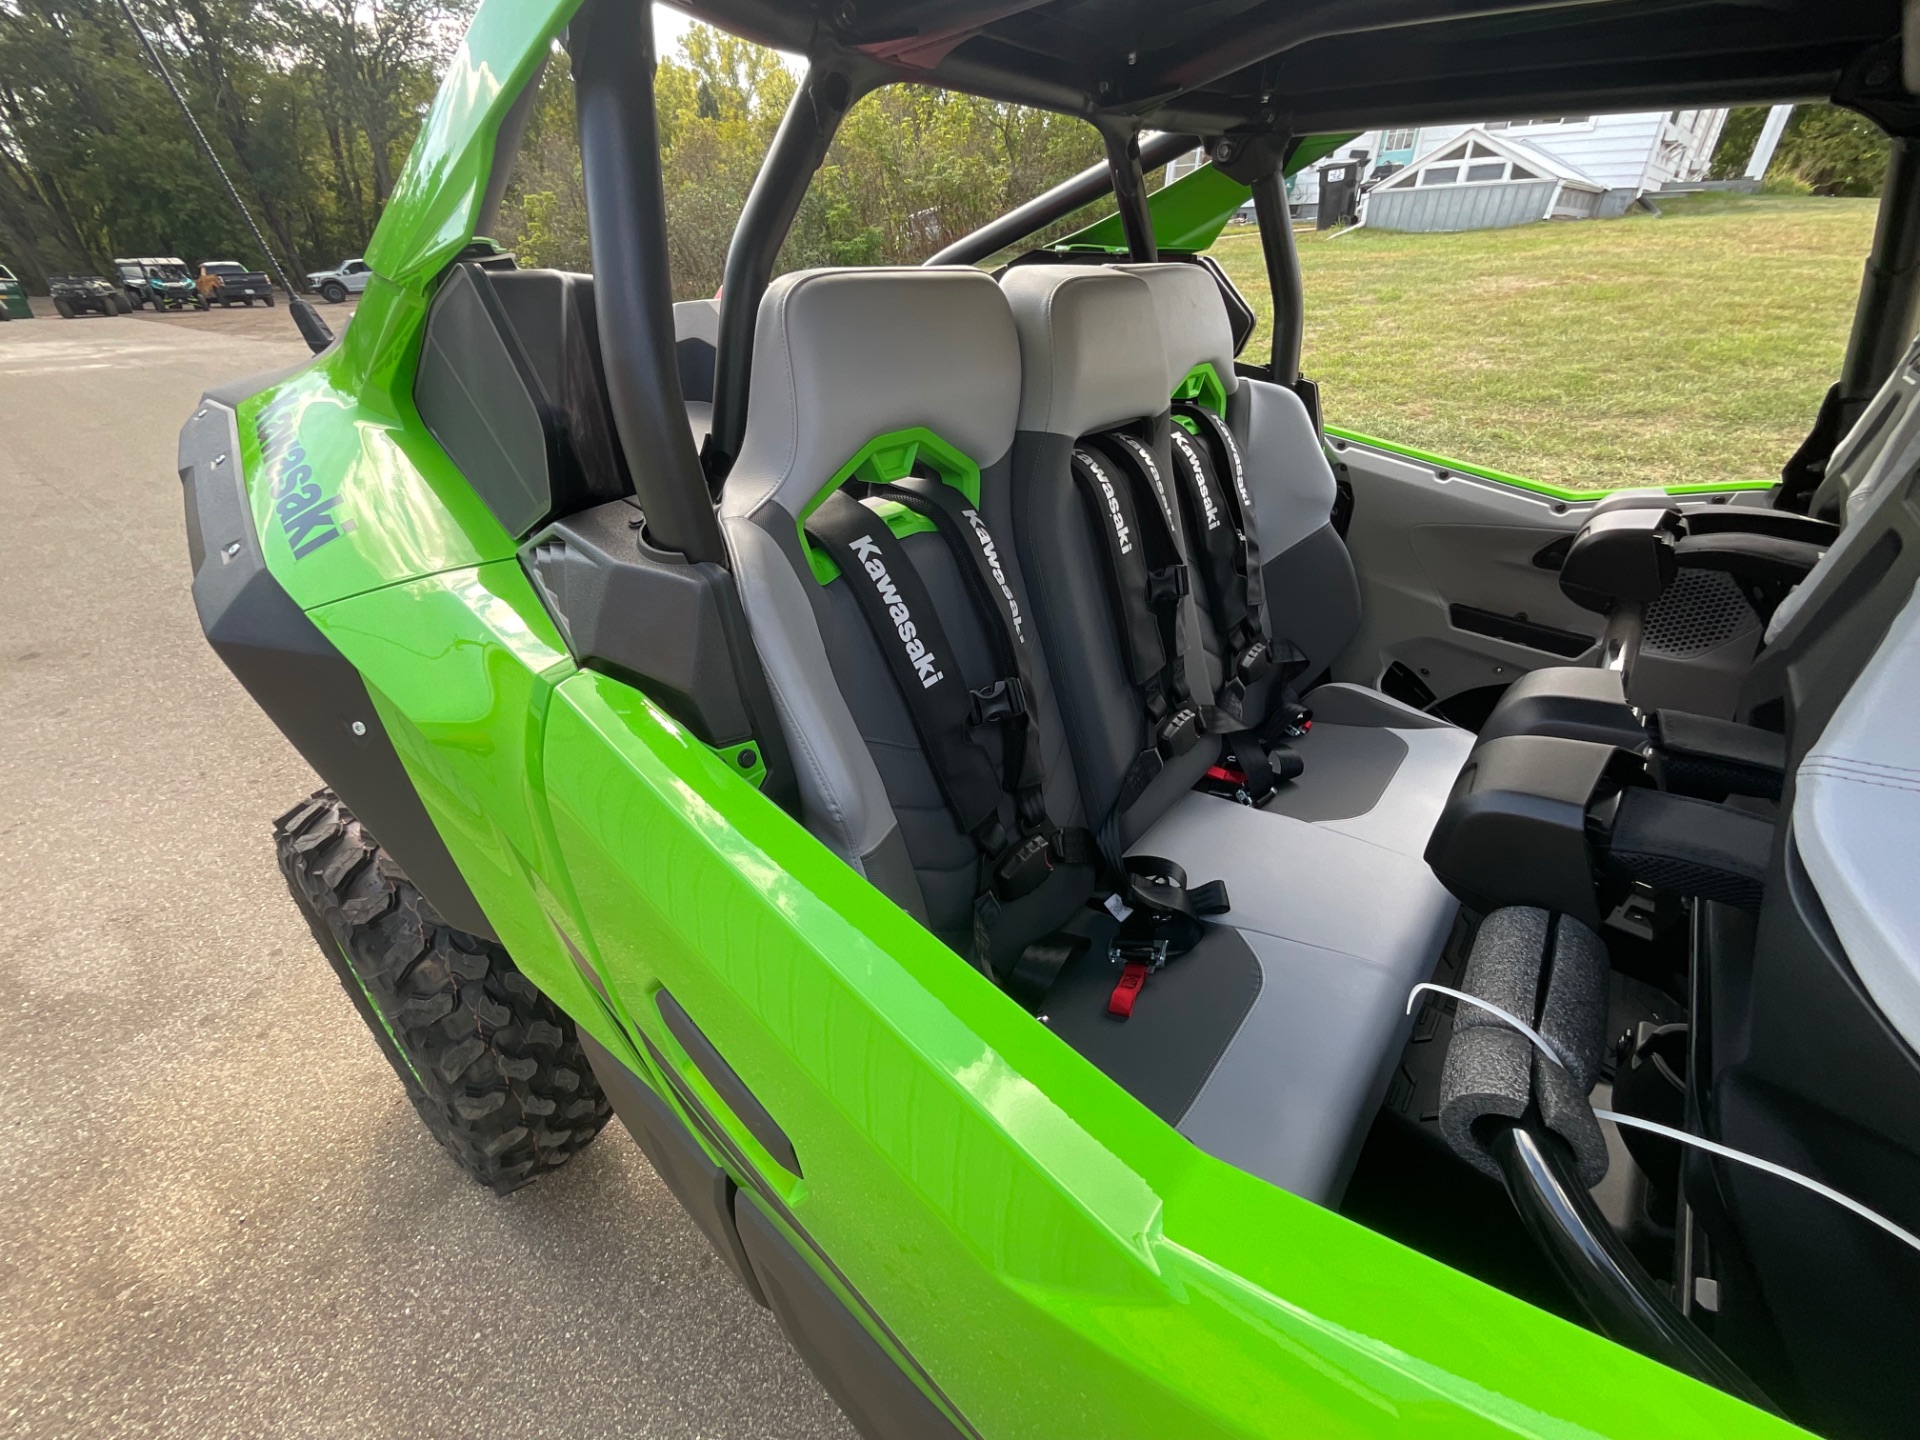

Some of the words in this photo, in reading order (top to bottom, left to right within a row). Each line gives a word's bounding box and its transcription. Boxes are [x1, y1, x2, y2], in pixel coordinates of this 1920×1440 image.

[255, 387, 358, 561] Kawasaki
[1170, 431, 1221, 530] Kawasaki
[1211, 414, 1251, 506] Kawasaki
[848, 534, 944, 689] Kawasaki
